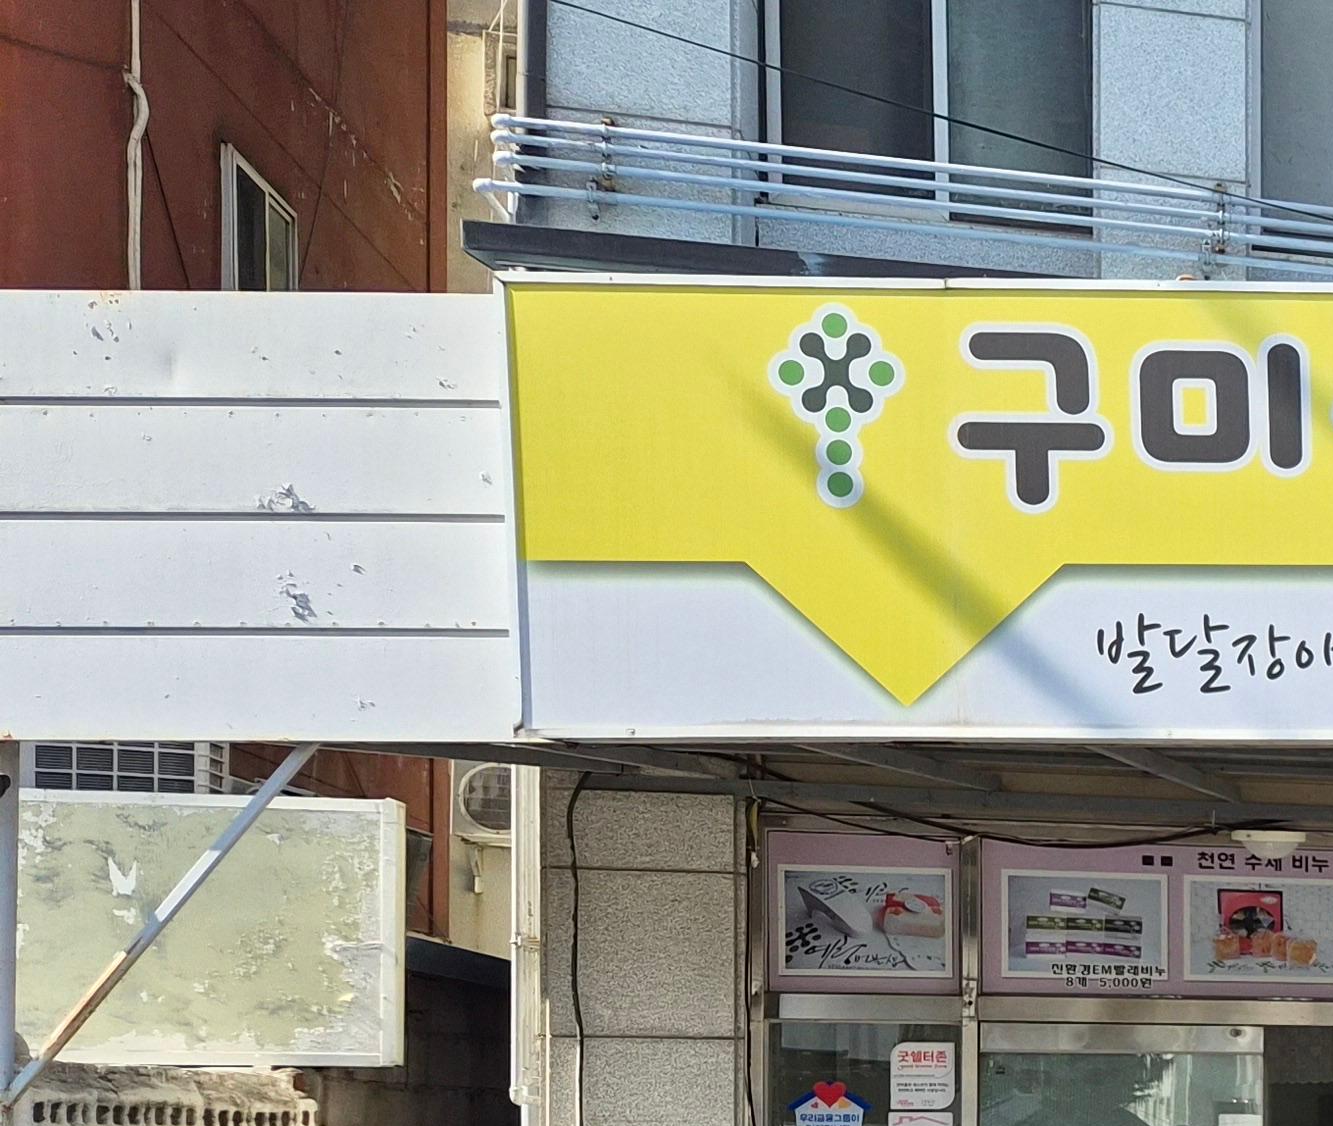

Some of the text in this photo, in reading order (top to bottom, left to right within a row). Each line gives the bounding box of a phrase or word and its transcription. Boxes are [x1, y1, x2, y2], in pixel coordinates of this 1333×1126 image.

[1197, 851, 1236, 870] 천연
[1292, 855, 1329, 873] 비누
[1065, 977, 1152, 989] 8개 5,000원
